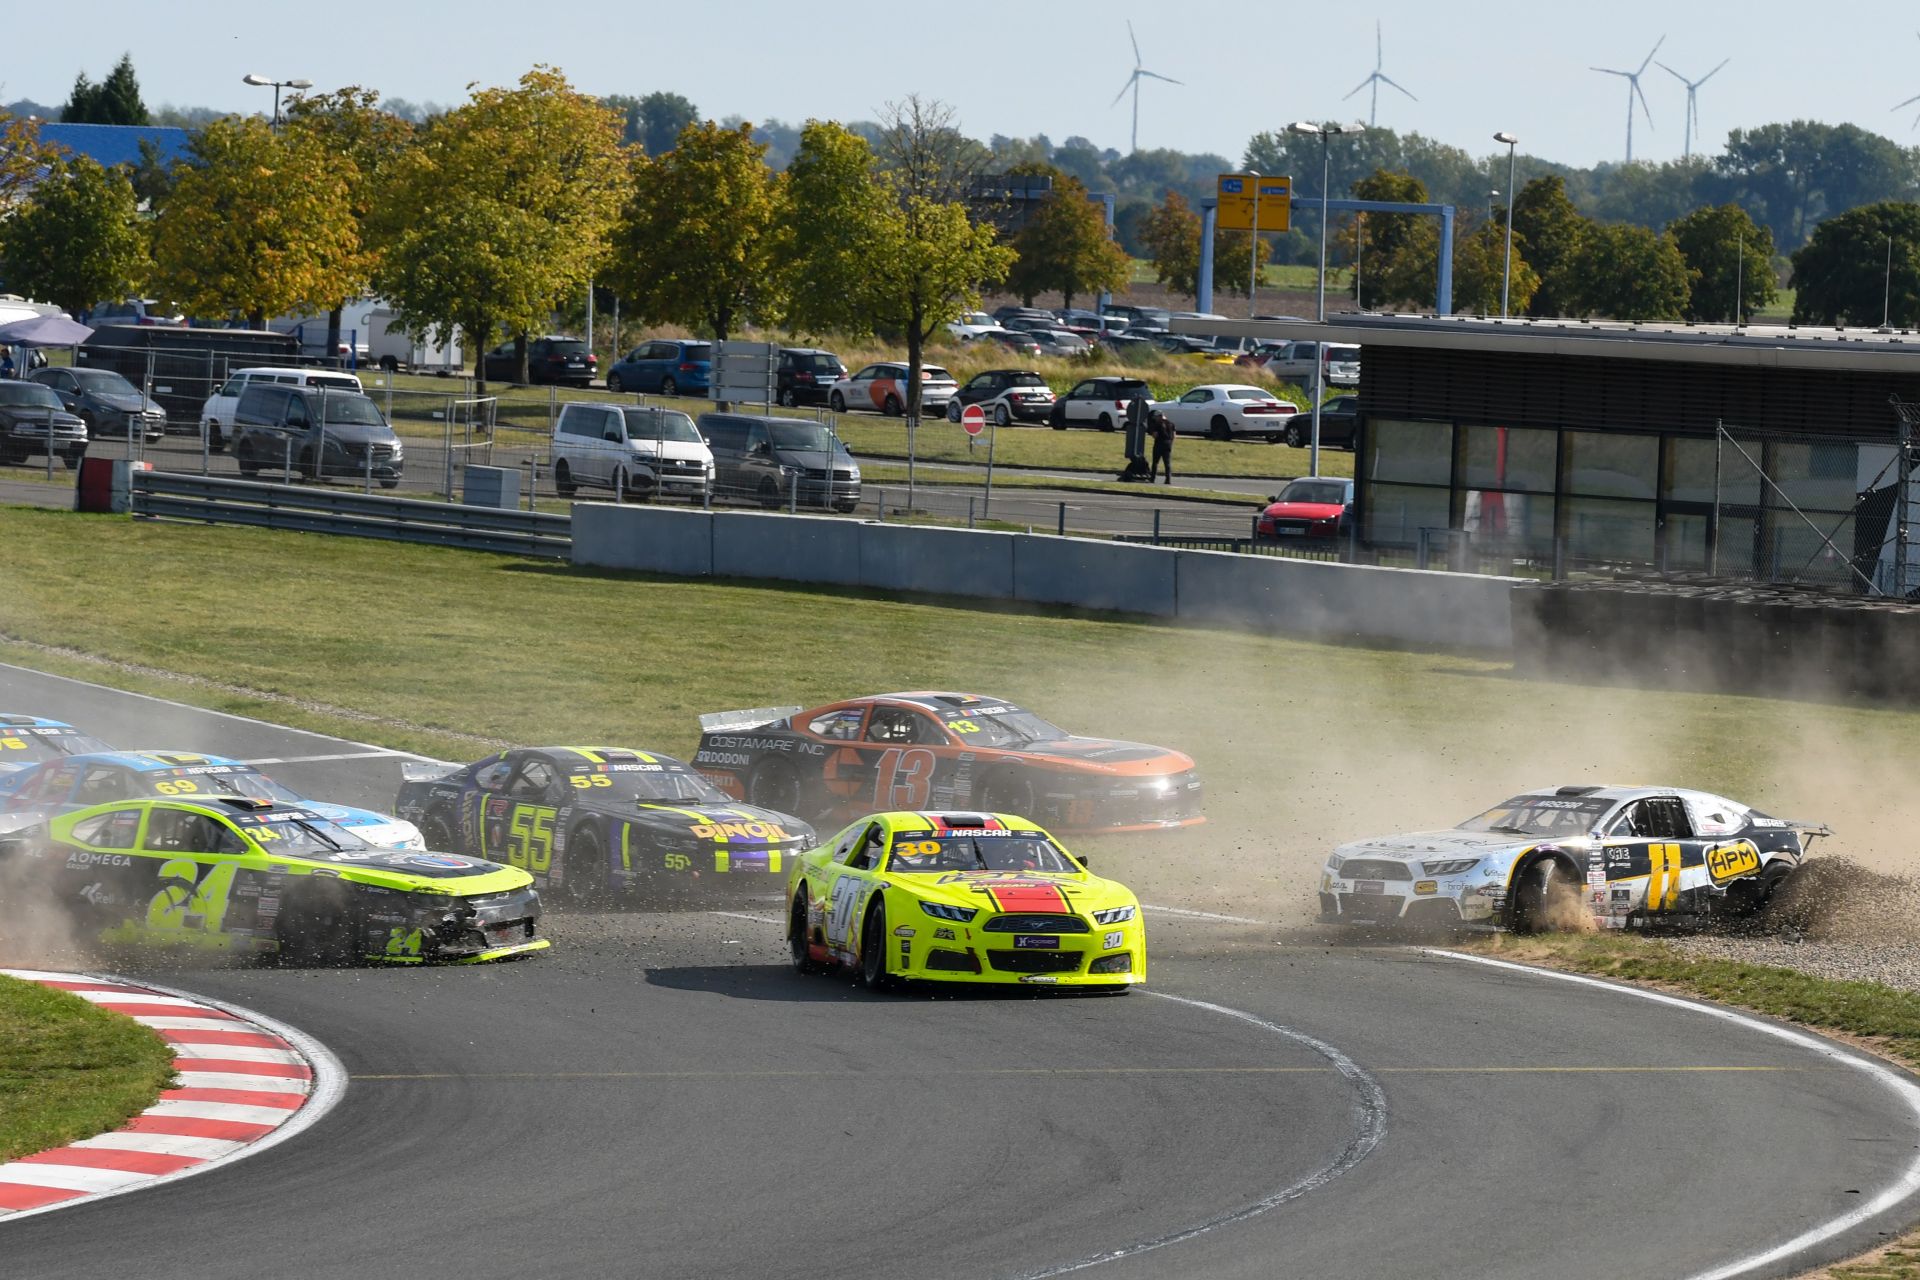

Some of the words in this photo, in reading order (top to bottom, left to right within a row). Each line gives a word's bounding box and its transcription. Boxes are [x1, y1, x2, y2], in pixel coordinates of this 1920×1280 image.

[948, 720, 981, 734] 13
[708, 736, 793, 751] COSTAMARE
[798, 744, 825, 756] INC.
[710, 751, 750, 765] DODONI
[186, 766, 232, 775] NASCAR
[613, 764, 664, 772] NASCAR
[155, 779, 198, 795] 69
[569, 774, 613, 789] 55
[873, 748, 936, 811] 13
[1537, 801, 1583, 809] NASCAR
[244, 827, 281, 842] 24
[507, 802, 558, 874] 55
[688, 822, 790, 840] DINOIL
[952, 829, 1012, 837] NASCAR
[895, 841, 941, 857] 30
[1606, 847, 1631, 861] CAE
[67, 852, 131, 866] AOMEGA
[664, 853, 687, 871] 55
[1710, 850, 1755, 875] HPM
[1647, 843, 1681, 911] 11
[146, 858, 240, 934] 24
[386, 927, 423, 955] 24
[1103, 931, 1124, 949] 30
